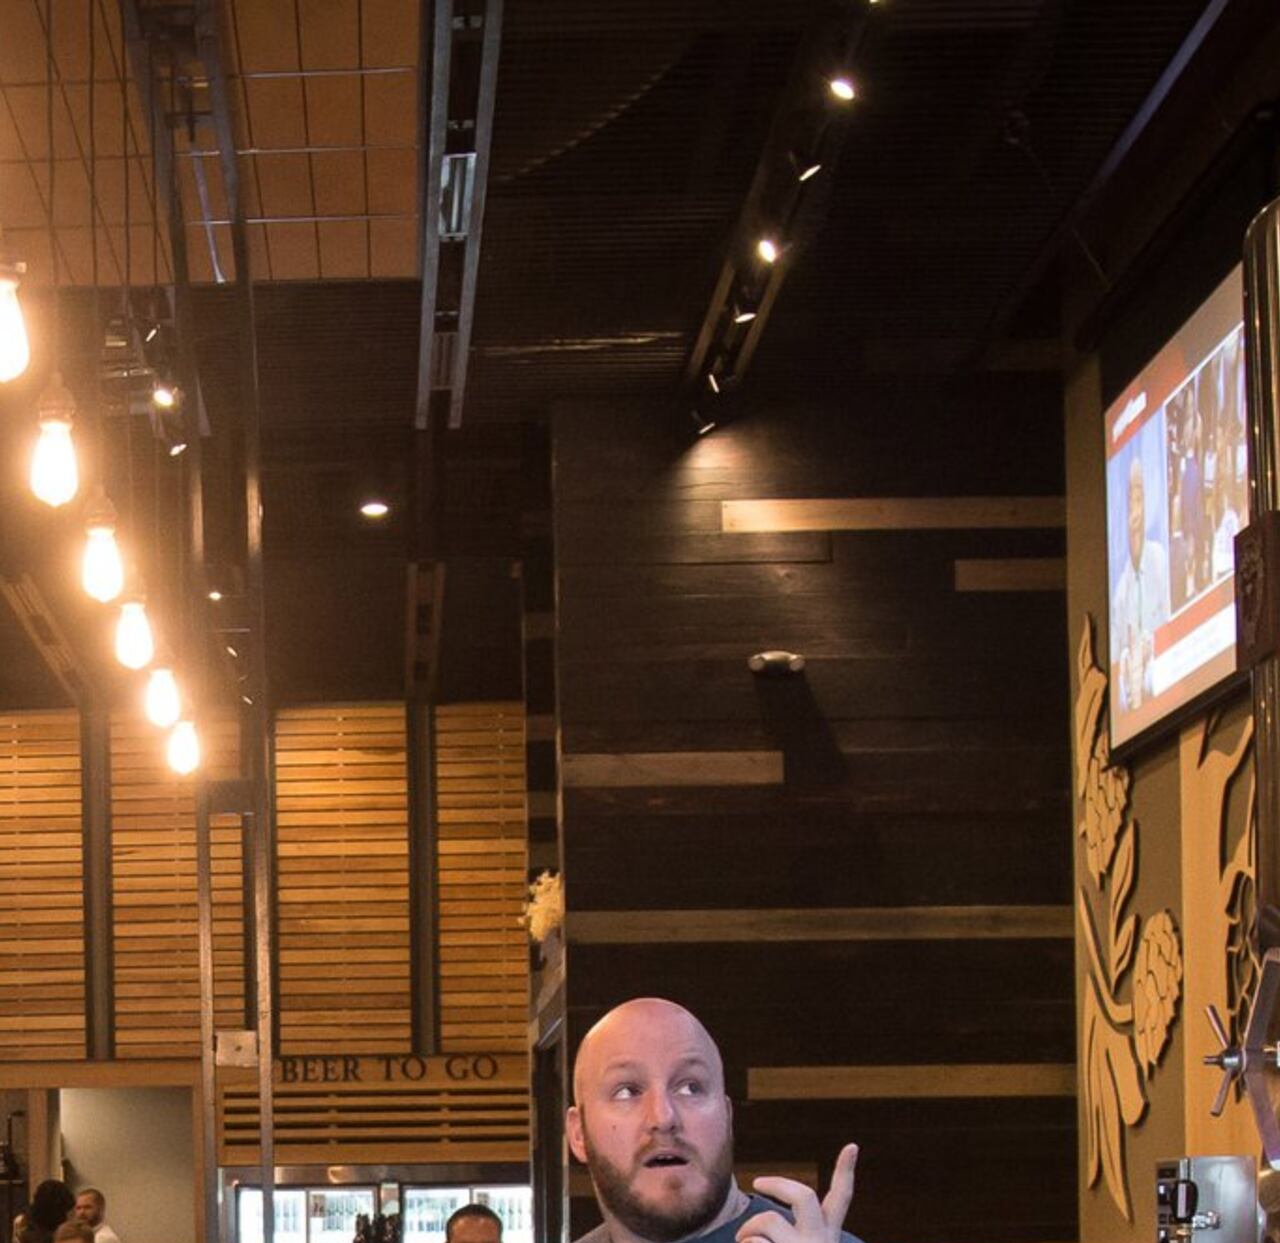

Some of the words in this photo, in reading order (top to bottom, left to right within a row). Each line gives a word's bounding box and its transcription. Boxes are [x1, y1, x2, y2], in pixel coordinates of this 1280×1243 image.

[280, 1056, 362, 1083] BEER
[378, 1055, 427, 1082] TO
[445, 1054, 498, 1081] GO
